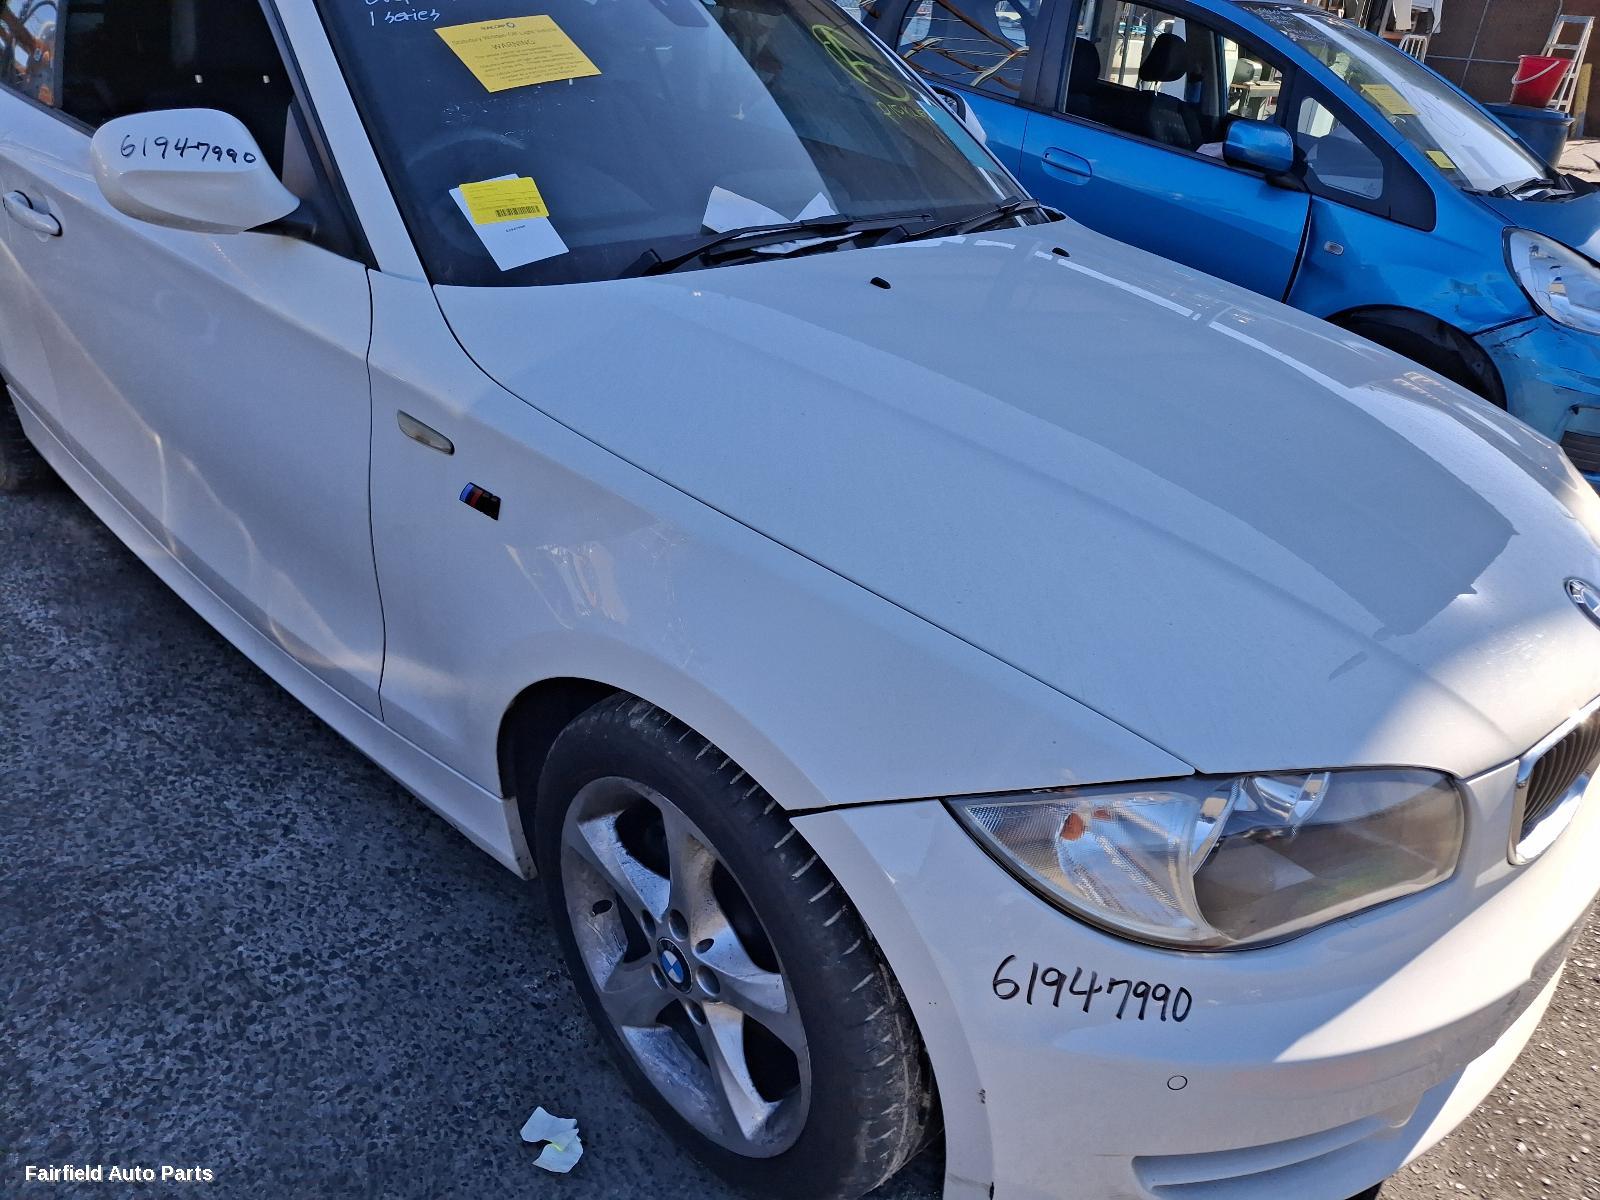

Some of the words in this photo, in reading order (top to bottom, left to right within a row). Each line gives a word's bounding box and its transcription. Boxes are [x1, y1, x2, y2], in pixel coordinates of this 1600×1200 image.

[384, 8, 441, 24] series
[491, 39, 536, 50] WARNING
[992, 954, 1193, 1022] 61947990
